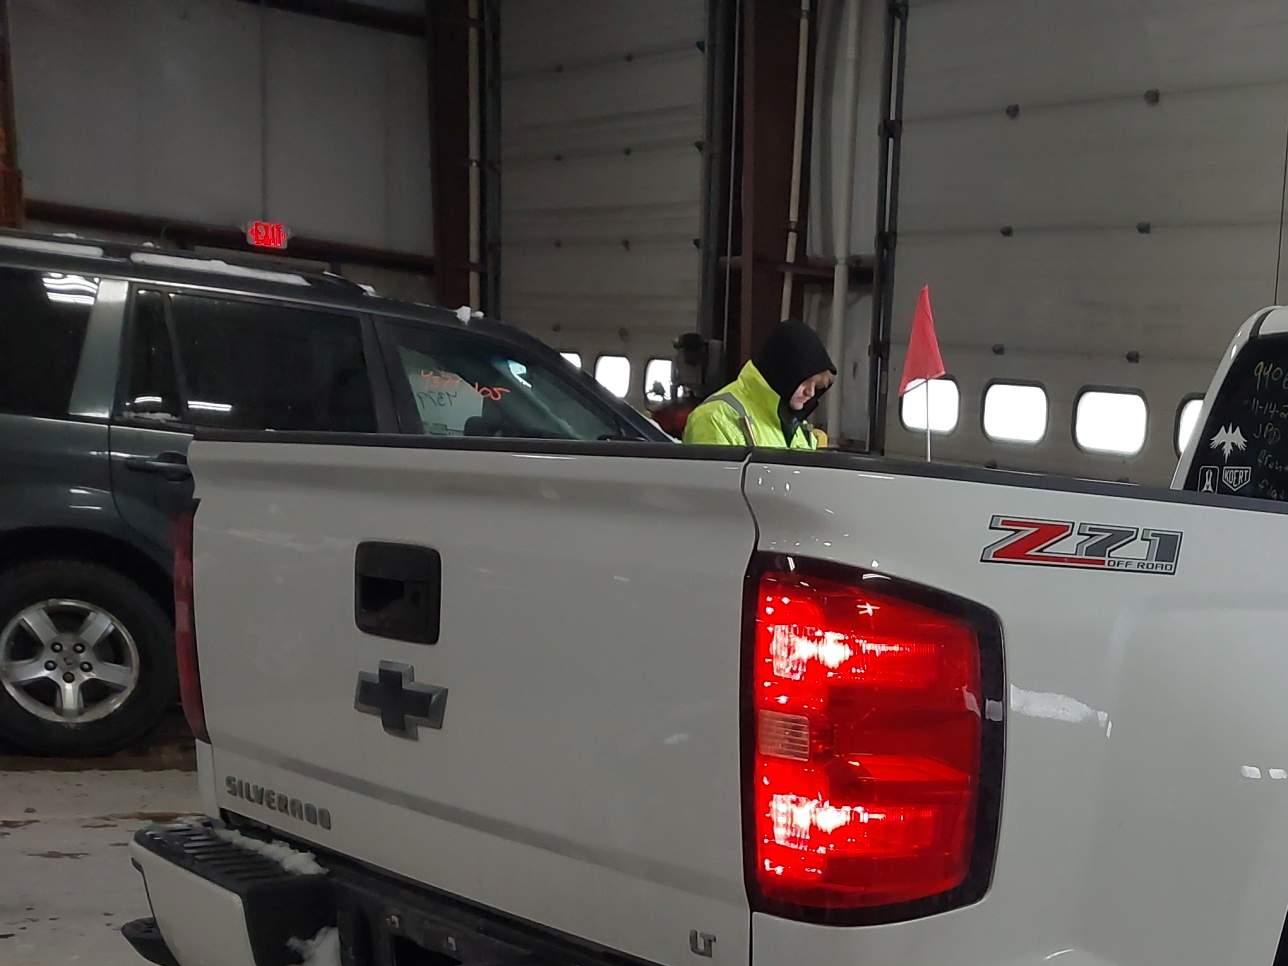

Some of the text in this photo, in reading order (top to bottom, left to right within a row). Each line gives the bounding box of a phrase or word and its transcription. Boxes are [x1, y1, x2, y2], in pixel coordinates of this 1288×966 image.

[1224, 469, 1249, 487] KOERT
[980, 515, 1183, 575] Z71
[1107, 559, 1173, 571] OFF ROAD
[225, 776, 332, 830] SILVERADO
[690, 930, 716, 958] LT
